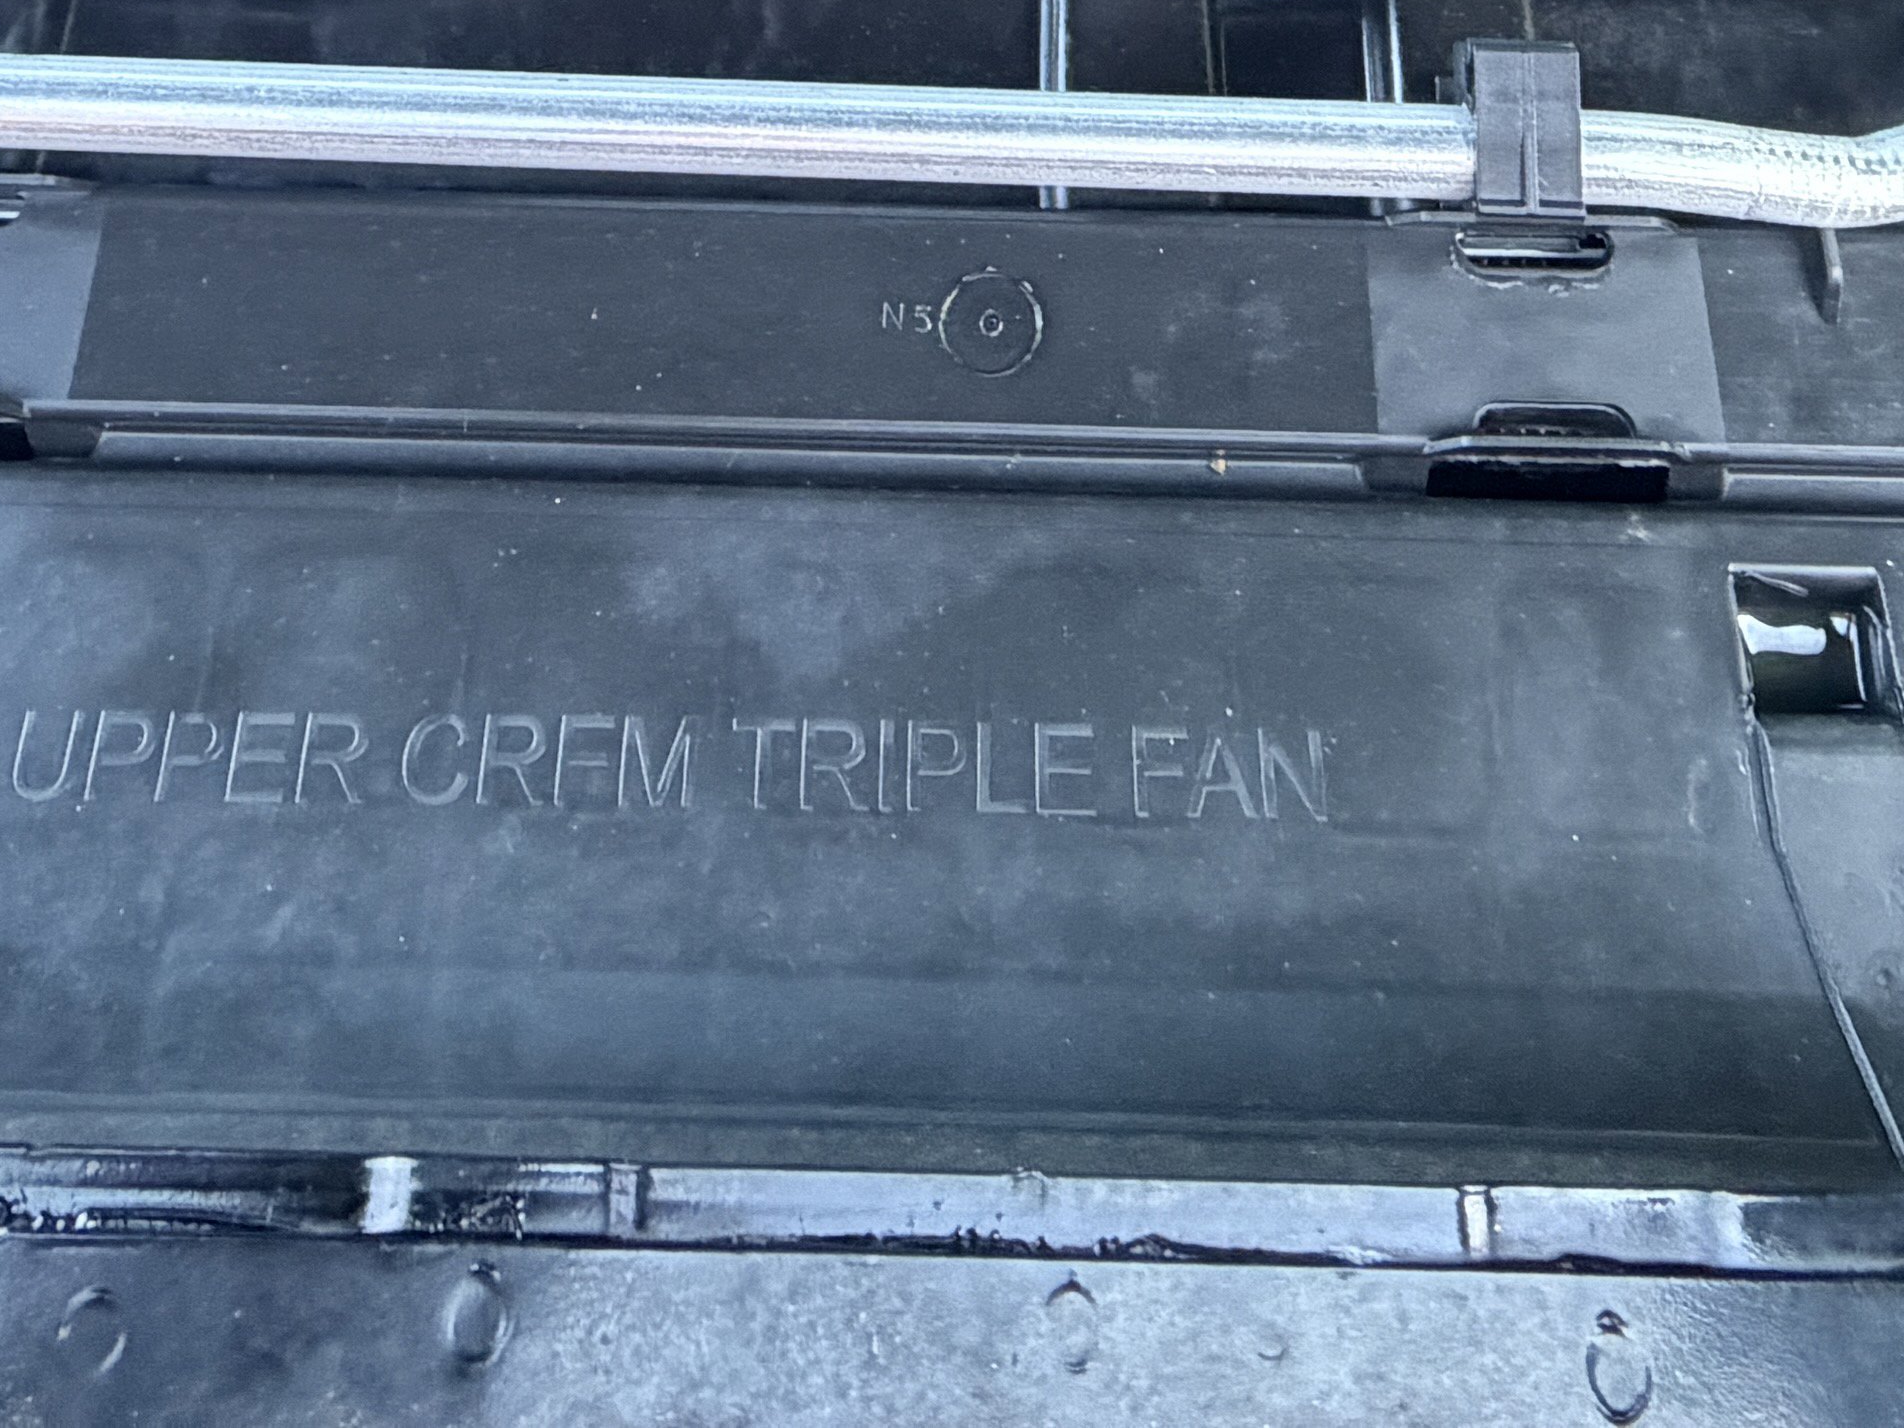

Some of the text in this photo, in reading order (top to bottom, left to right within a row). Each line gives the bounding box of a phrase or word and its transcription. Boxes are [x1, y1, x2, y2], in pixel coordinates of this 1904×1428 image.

[881, 302, 932, 334] N5
[12, 709, 1328, 822] UPPER CRFM TRIPLE FAN
